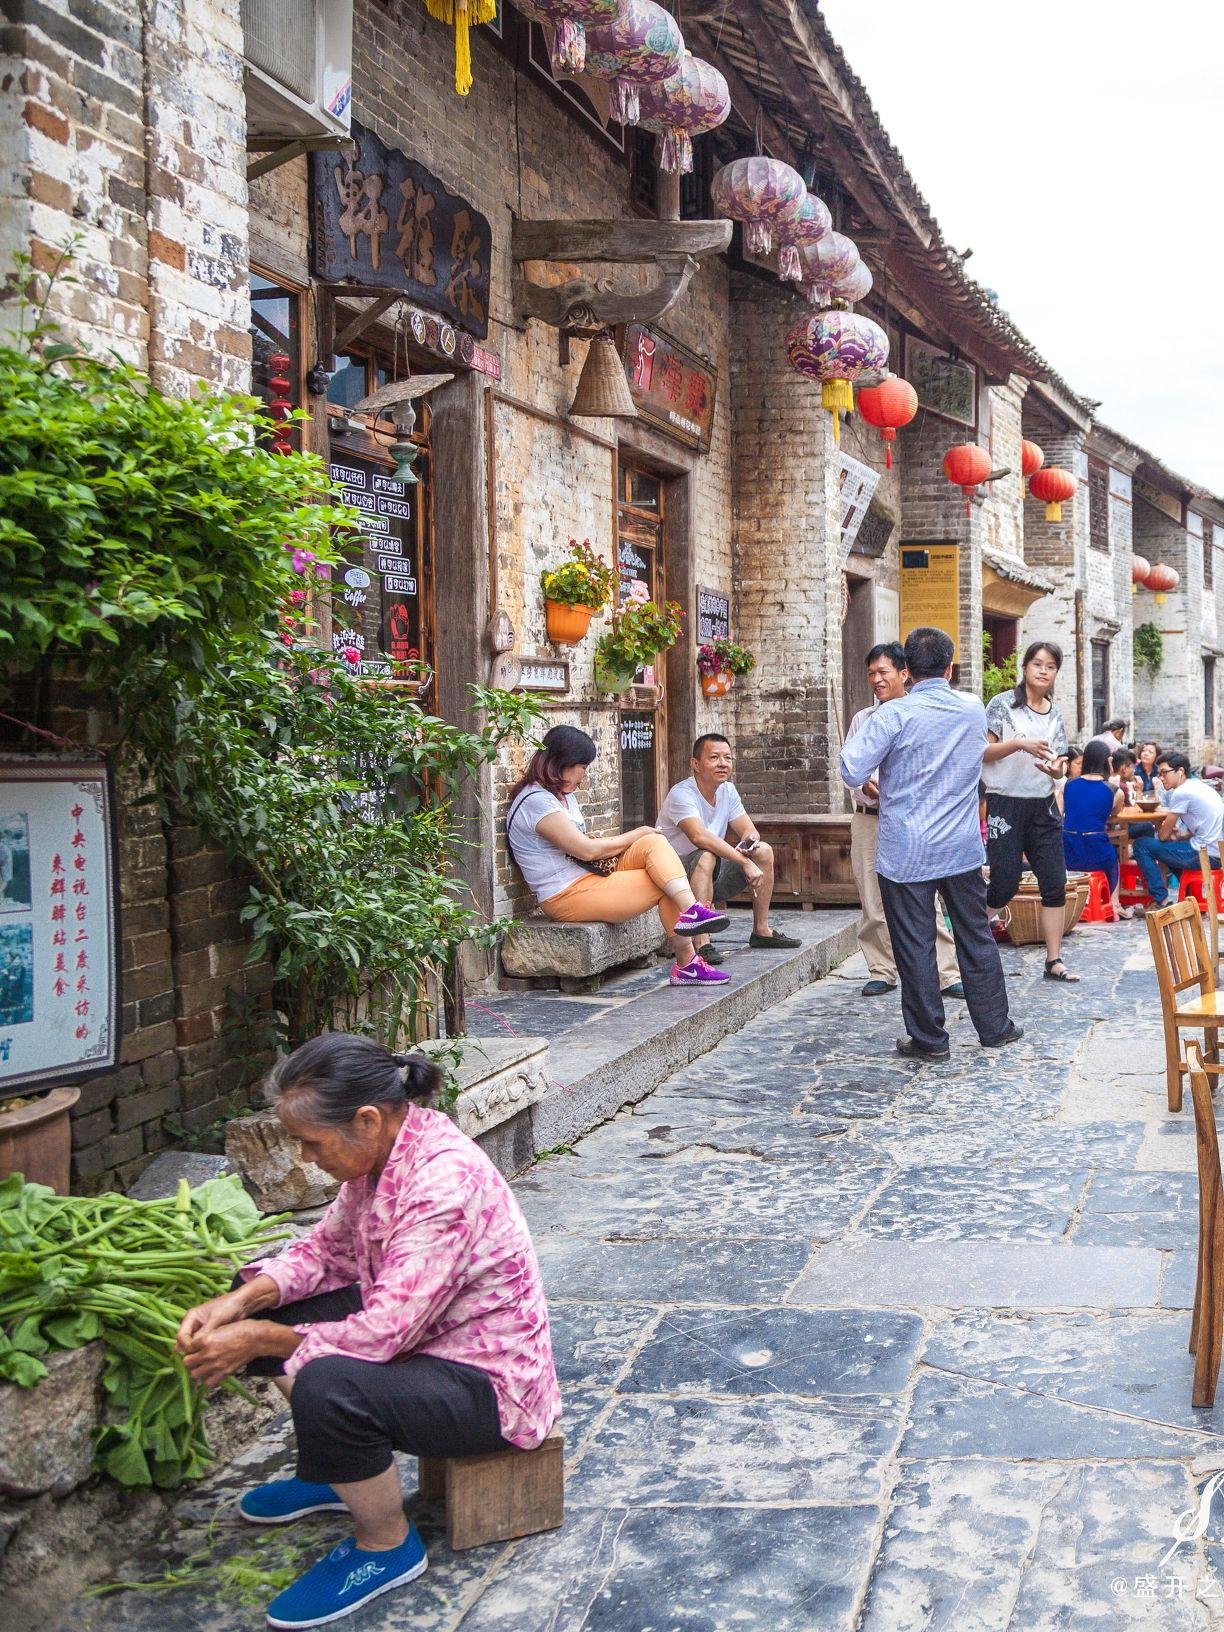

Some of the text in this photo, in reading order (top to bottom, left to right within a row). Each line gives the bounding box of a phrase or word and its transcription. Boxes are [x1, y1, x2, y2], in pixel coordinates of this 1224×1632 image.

[71, 803, 90, 1040] 中央电视台二度采访的
